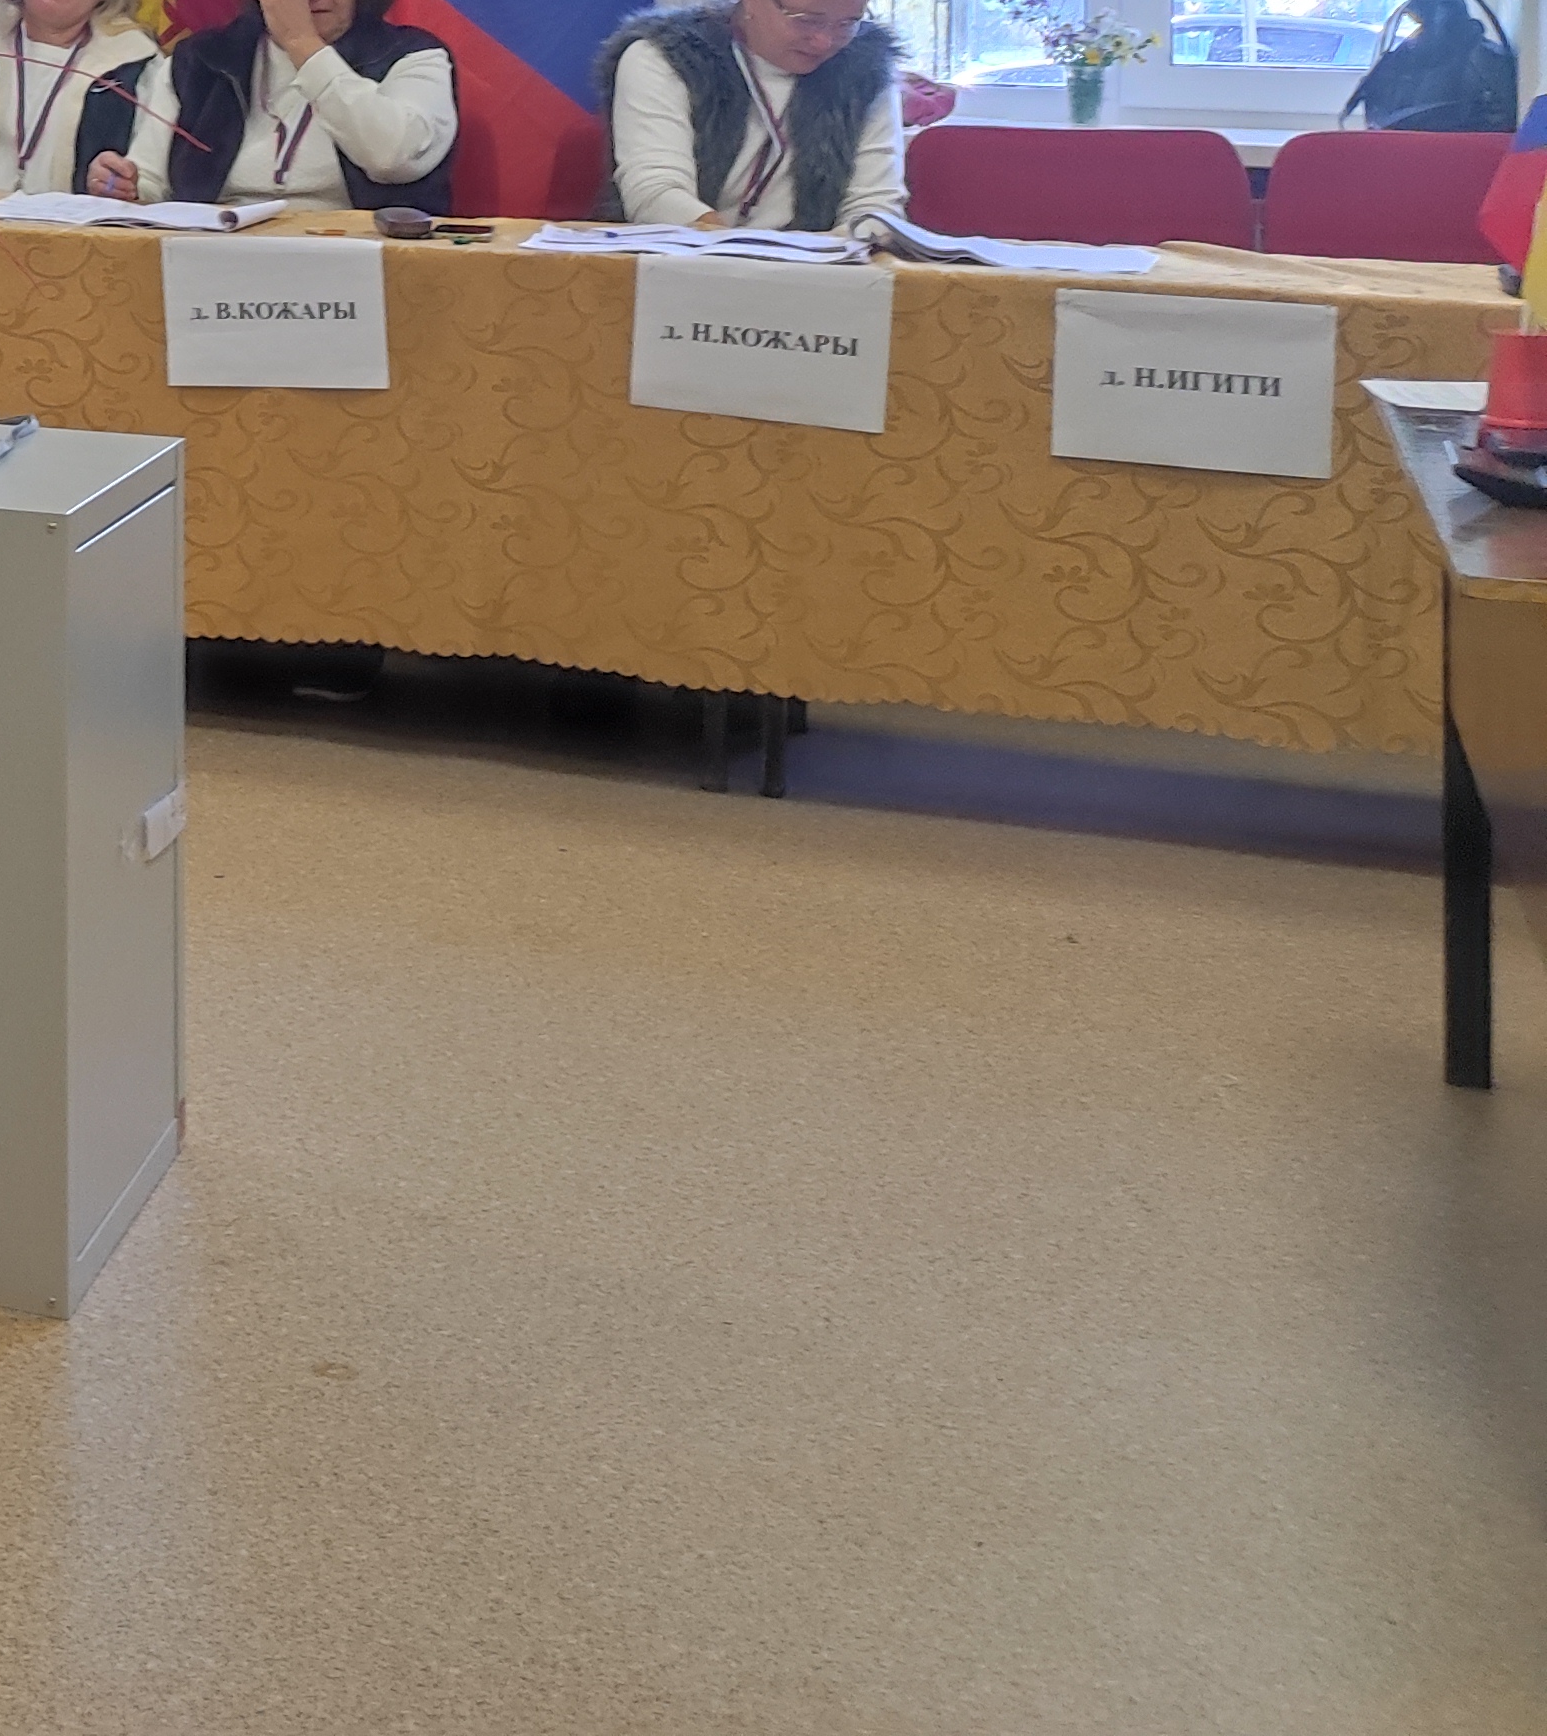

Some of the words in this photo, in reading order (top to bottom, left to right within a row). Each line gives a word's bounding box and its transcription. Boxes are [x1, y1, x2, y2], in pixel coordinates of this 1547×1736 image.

[215, 301, 356, 321] В.КОЖАРЫ
[691, 322, 859, 357] Н.КОЖАРЫ
[1099, 370, 1126, 386] д.
[1133, 367, 1282, 397] Н.ИГИТИ
